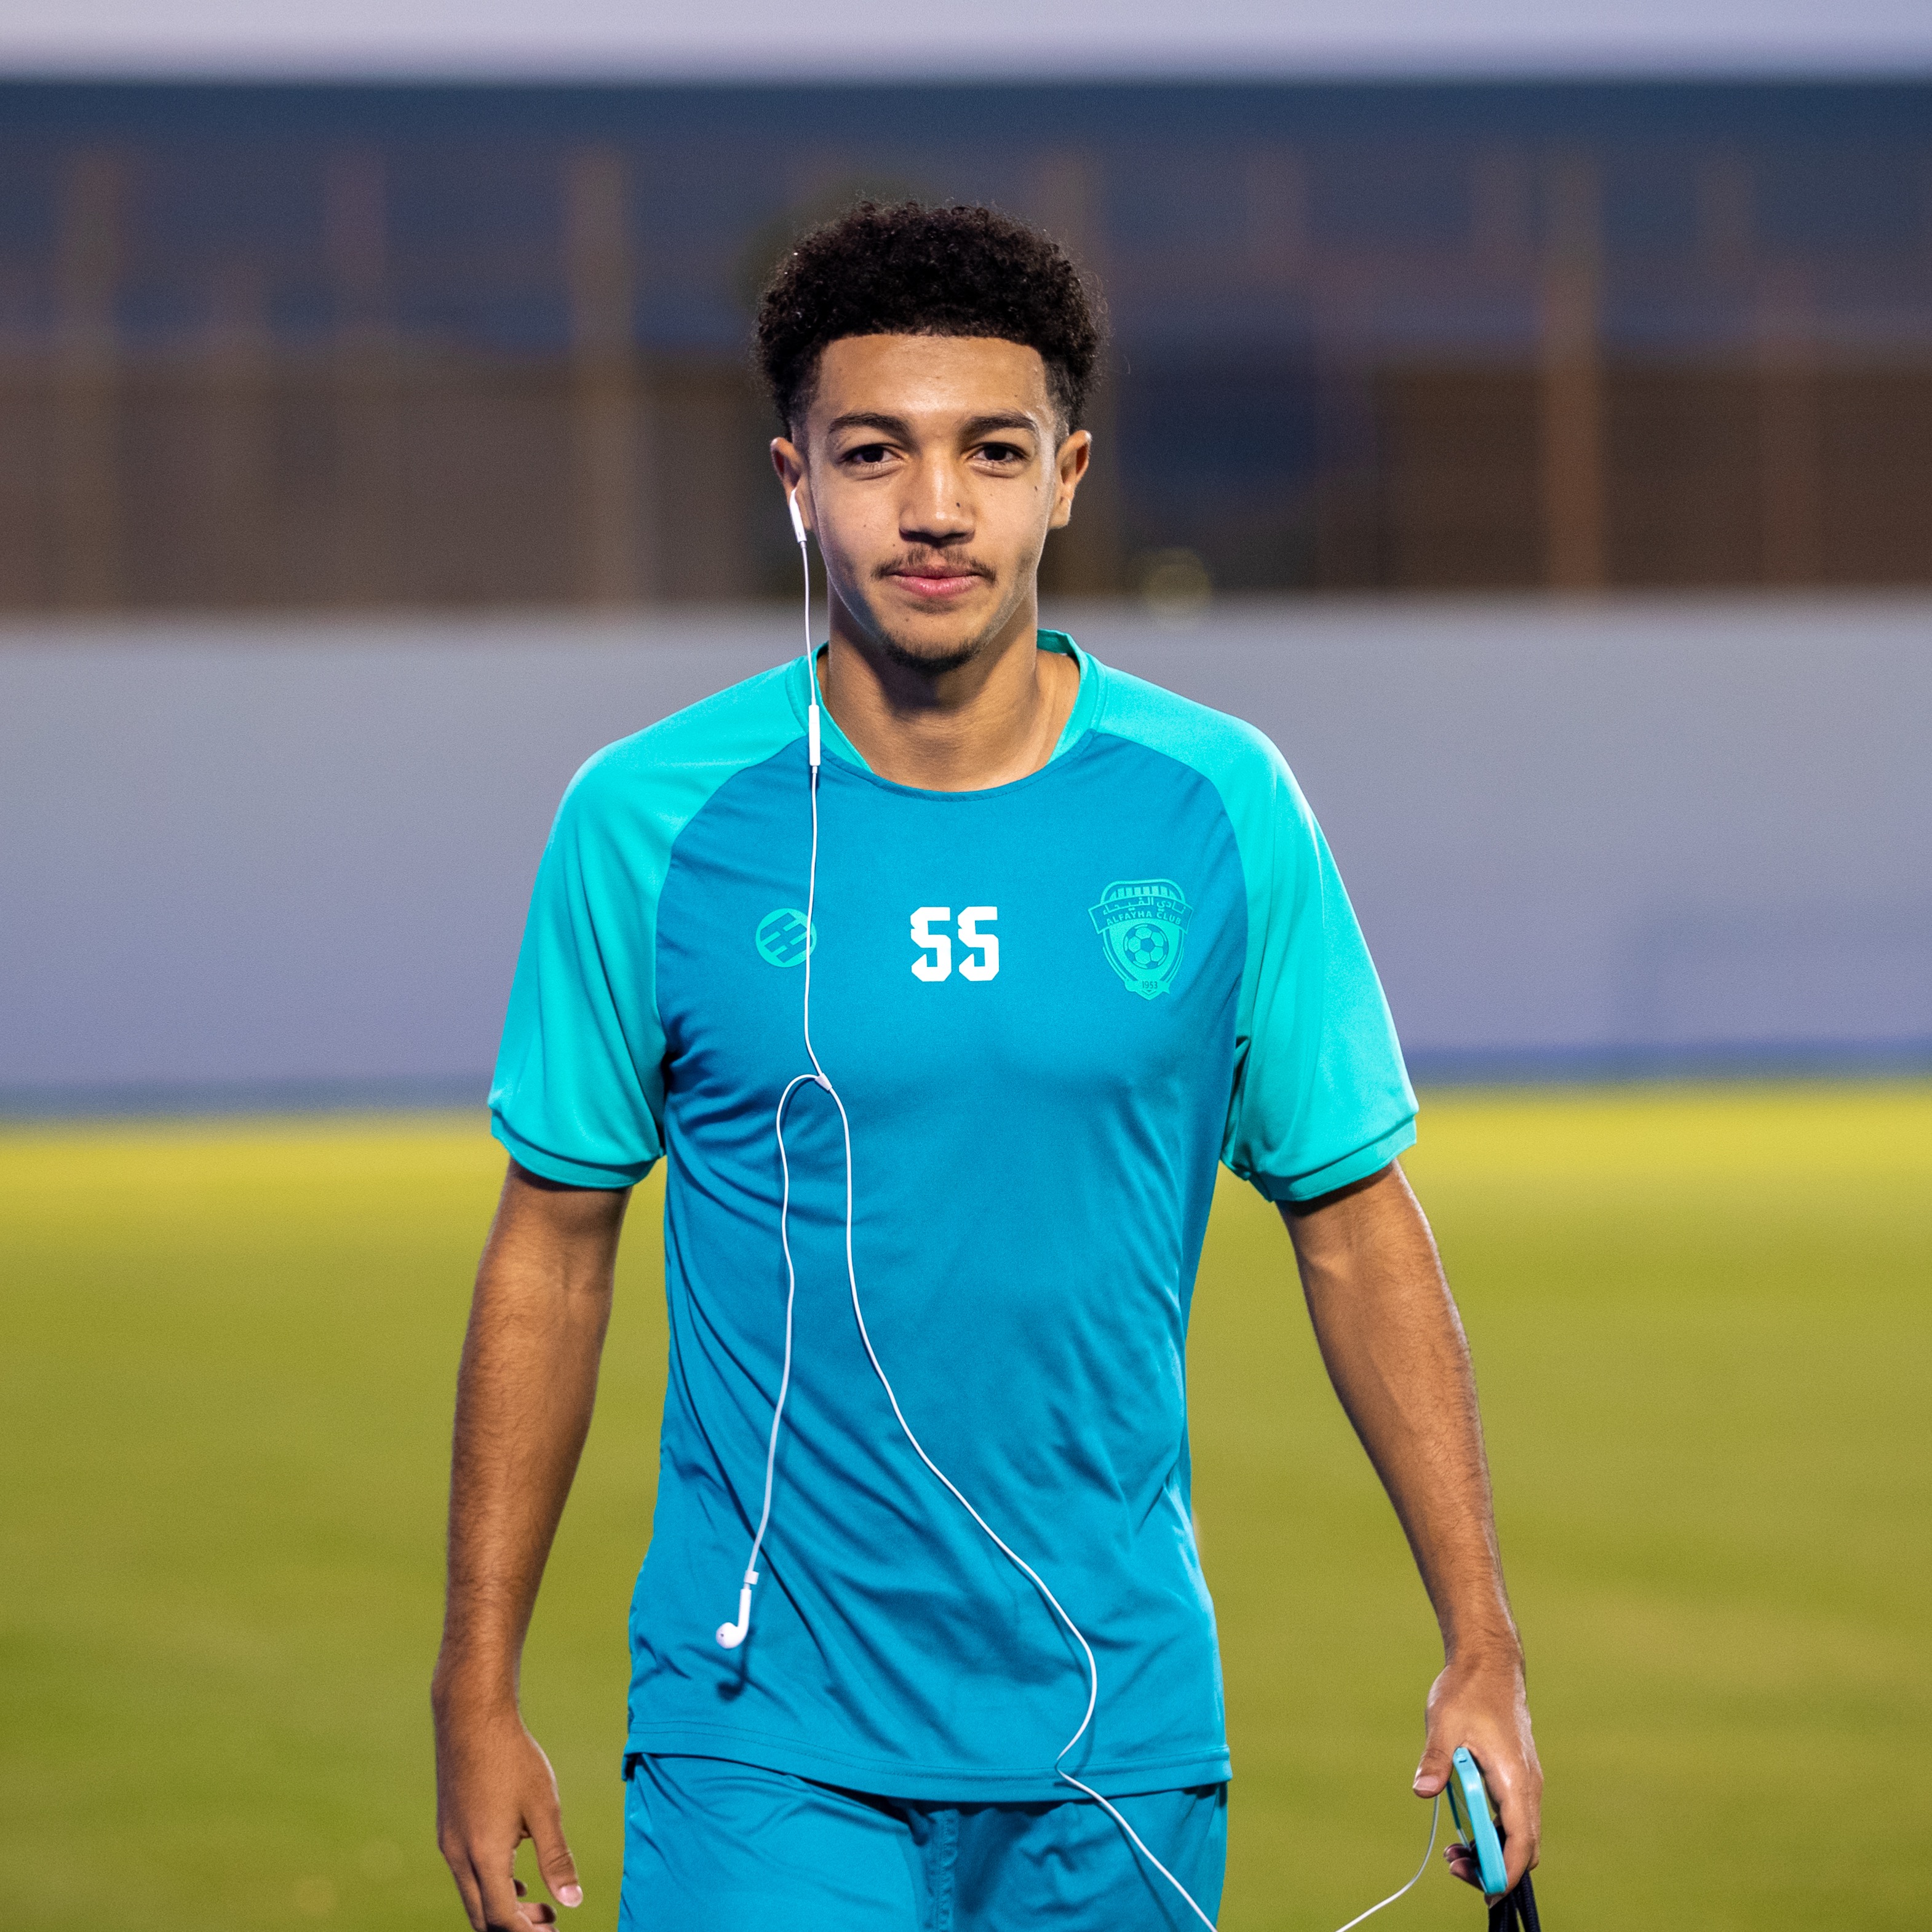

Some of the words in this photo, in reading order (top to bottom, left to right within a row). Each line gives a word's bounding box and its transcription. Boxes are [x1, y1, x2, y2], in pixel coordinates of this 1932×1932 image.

[1107, 910, 1152, 926] ALFAYHA
[1156, 912, 1181, 925] CLUB
[1142, 980, 1158, 989] 1953
